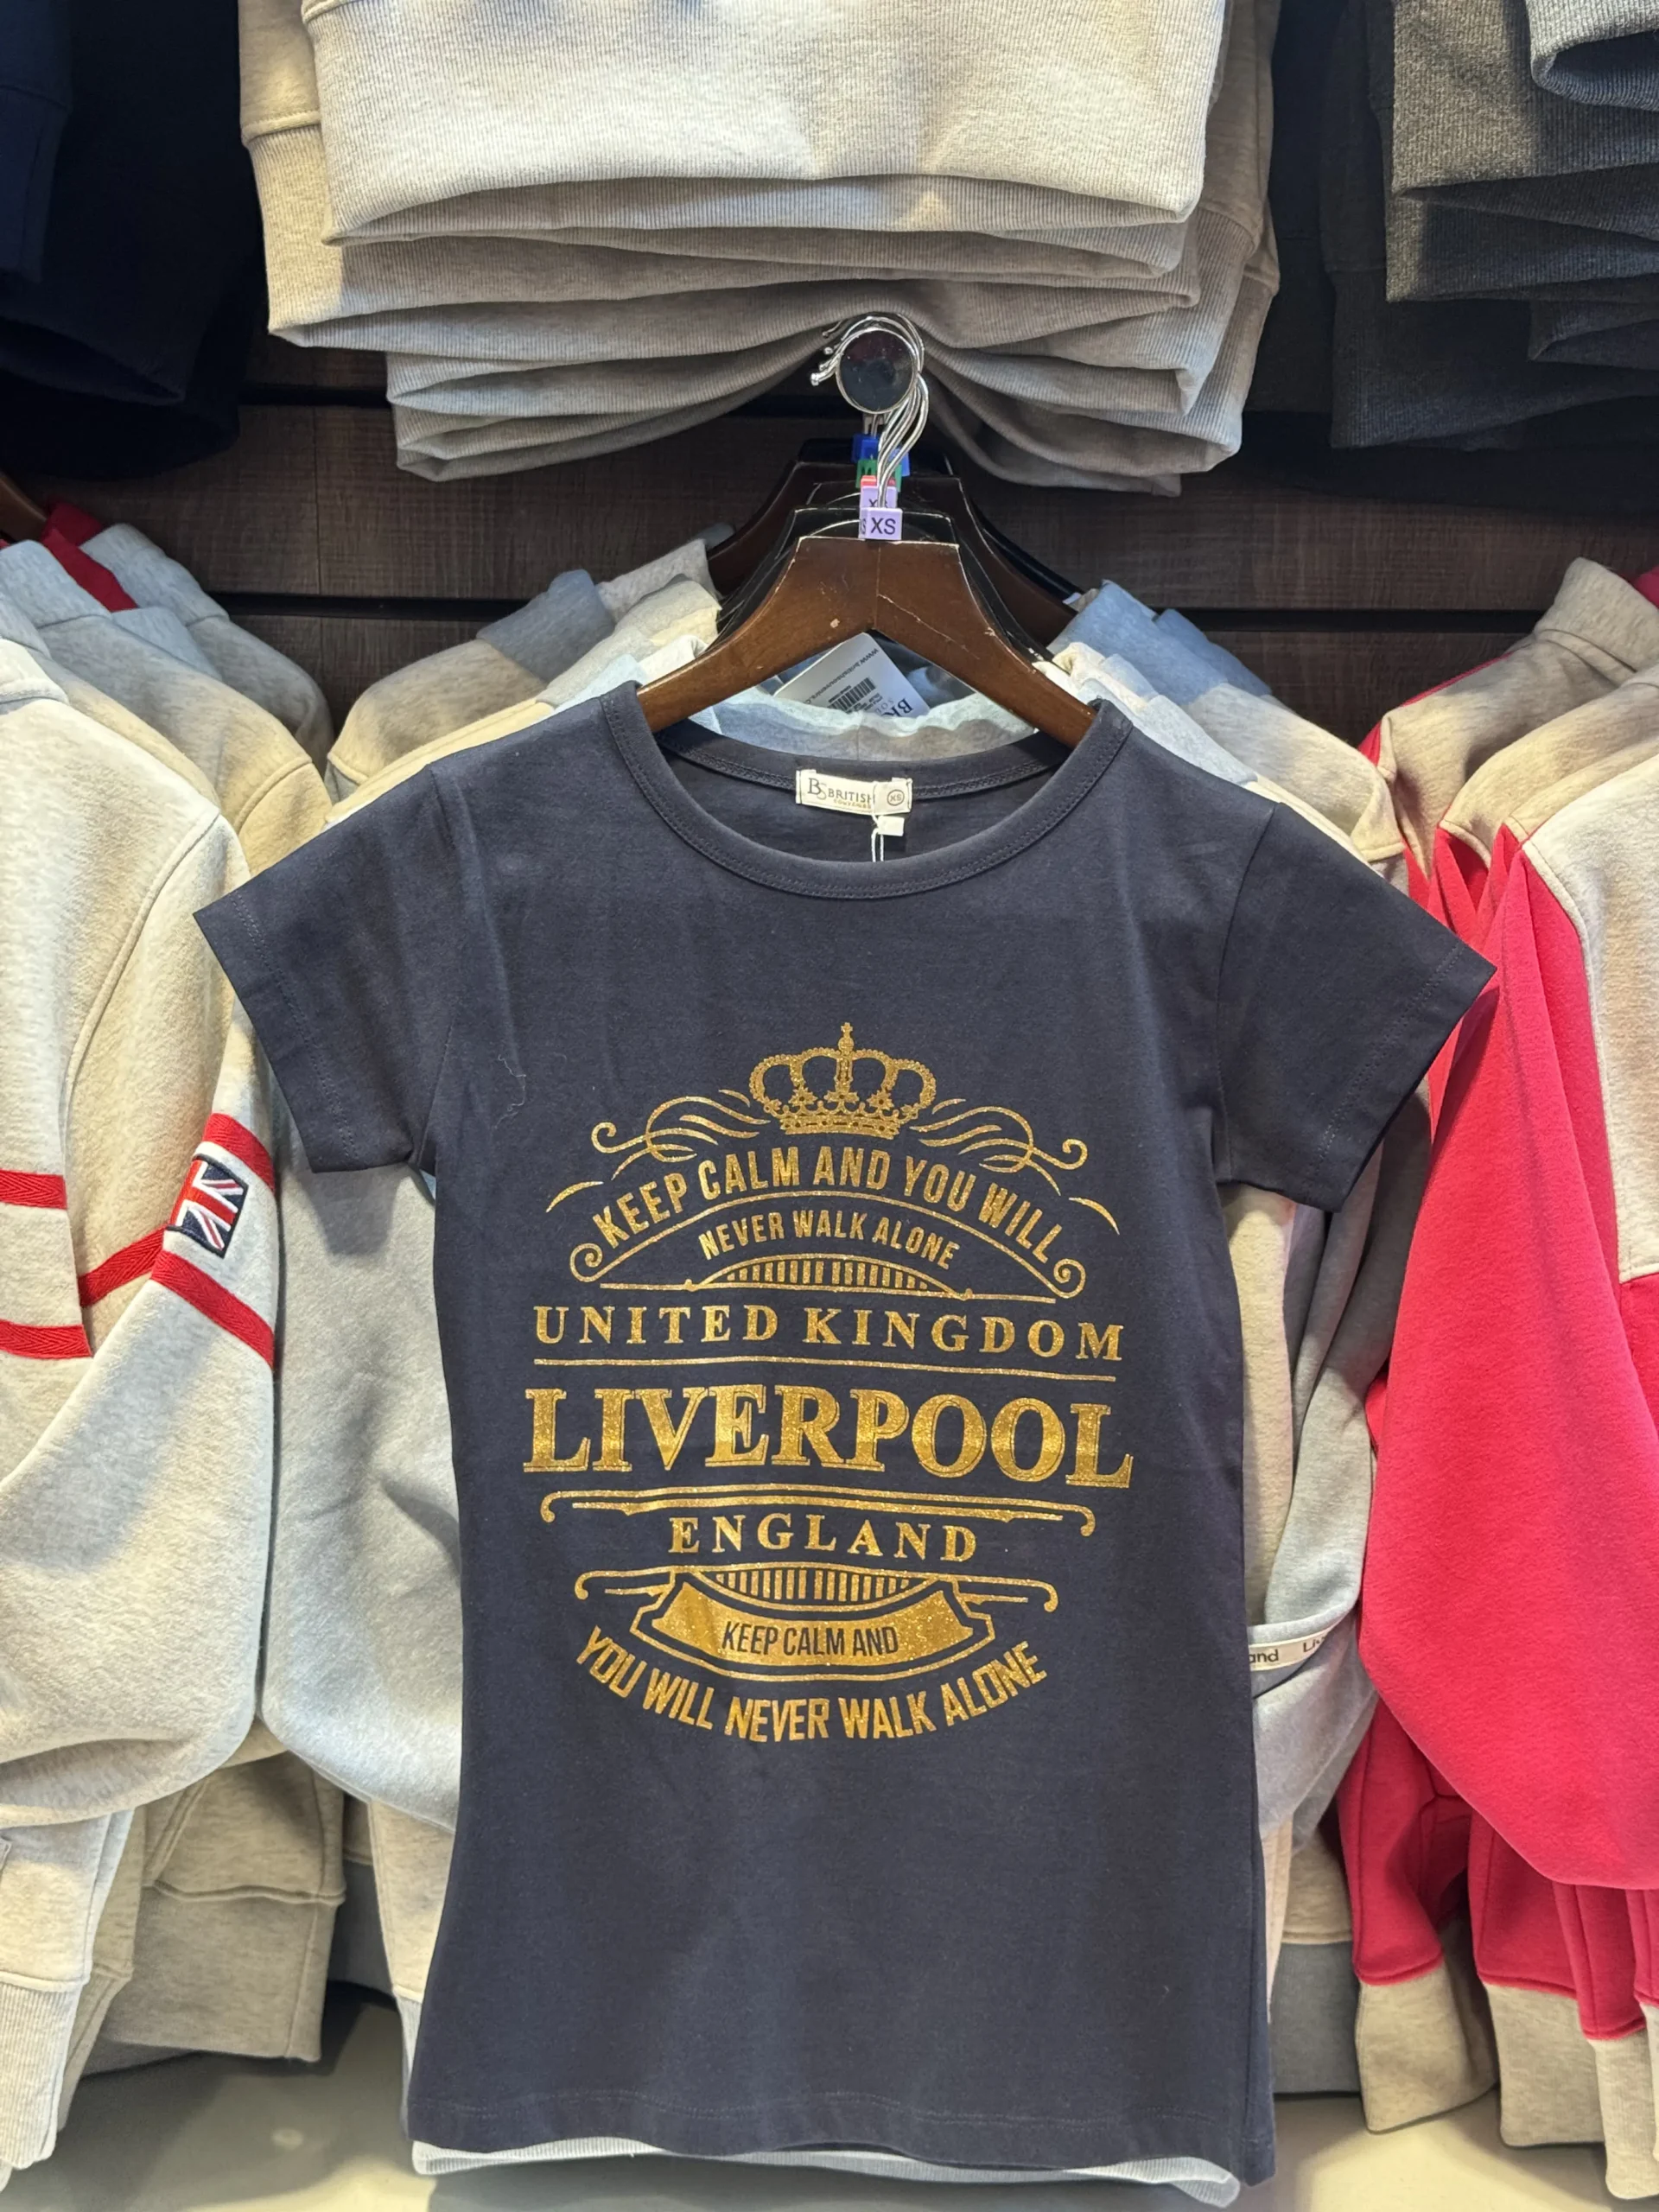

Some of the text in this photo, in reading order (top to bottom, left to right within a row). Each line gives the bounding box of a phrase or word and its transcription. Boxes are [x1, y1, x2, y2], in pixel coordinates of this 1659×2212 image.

[870, 517, 896, 535] XS
[593, 1147, 1064, 1263] KEEP CALM AND YOU WILL
[698, 1211, 961, 1268] NEVER WALK ALONE
[534, 1305, 1123, 1362] UNITED KINGDOM
[524, 1383, 1134, 1490] LIVERPOOL
[669, 1512, 977, 1562] ENGLAND
[721, 1621, 899, 1657] KEEP CALM AND
[575, 1626, 1047, 1743] YOU WILL NEVER WALK ALONE
